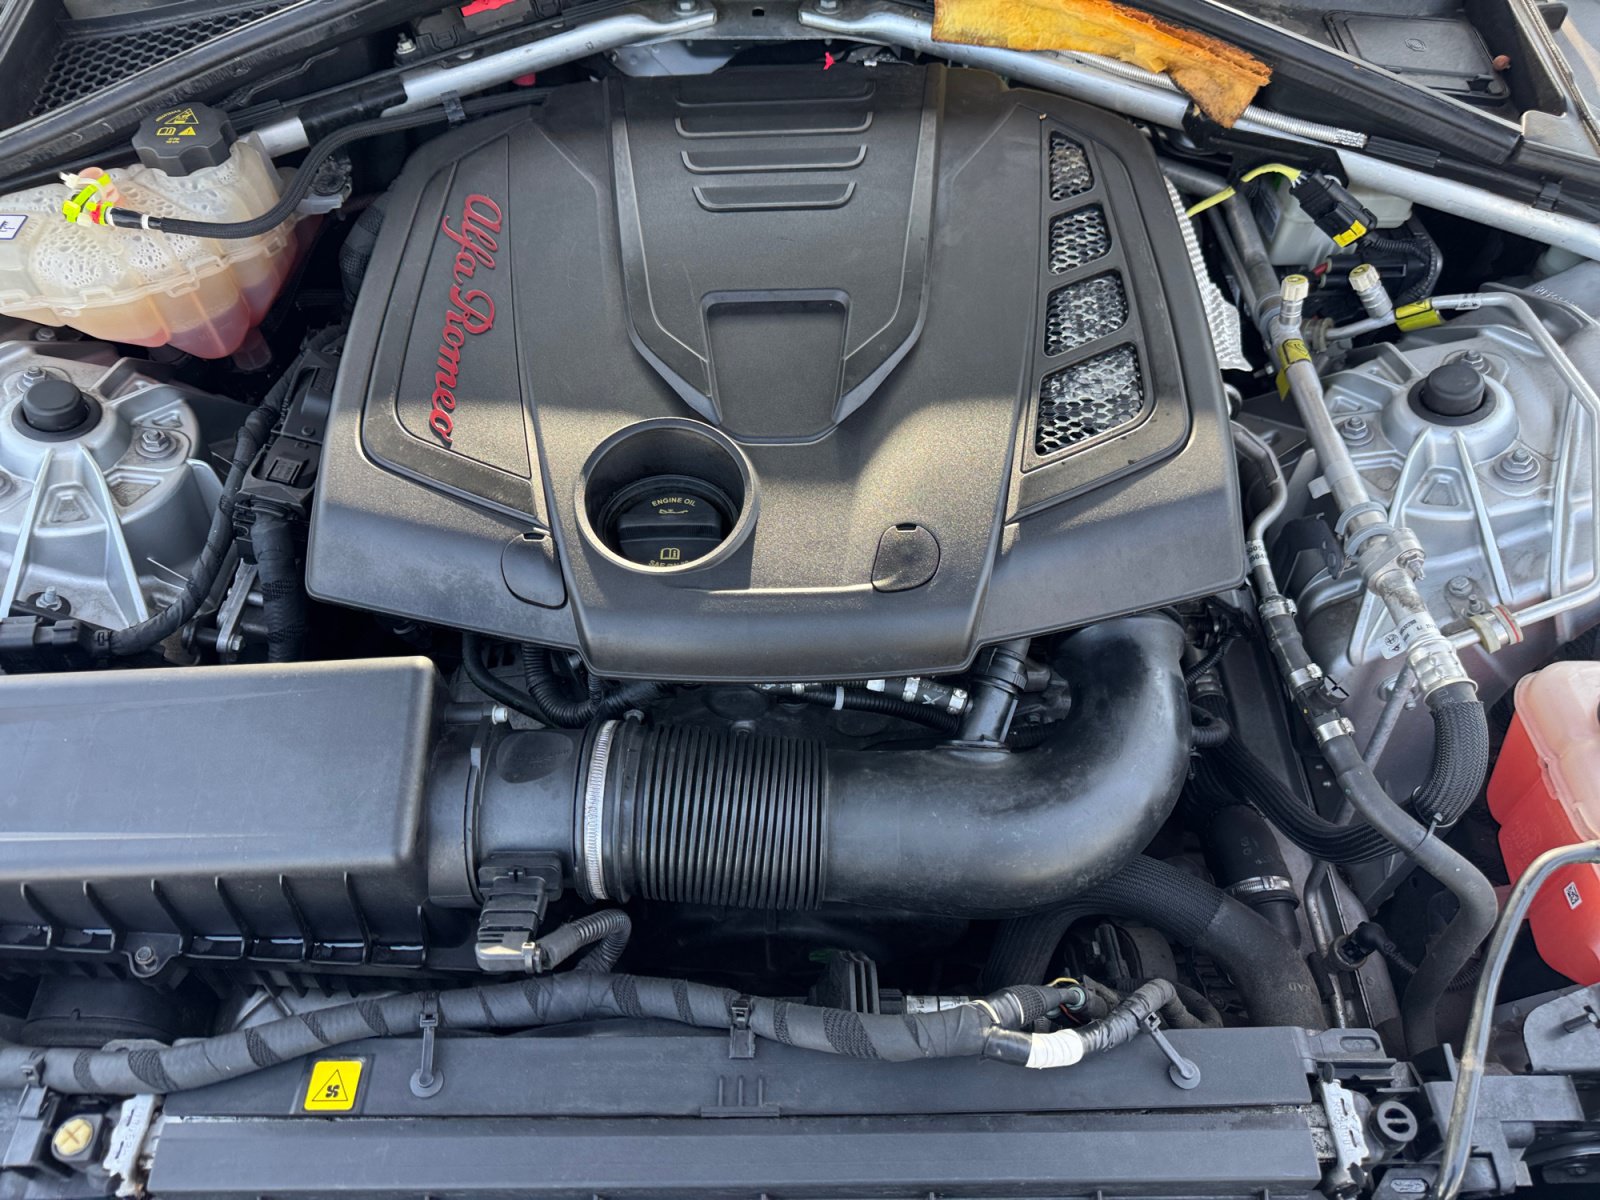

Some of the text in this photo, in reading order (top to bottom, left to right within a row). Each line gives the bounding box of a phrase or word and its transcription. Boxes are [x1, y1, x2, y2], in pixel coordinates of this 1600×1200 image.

[429, 194, 502, 443] Alfa Romeo
[651, 497, 696, 507] ENGINE OIL
